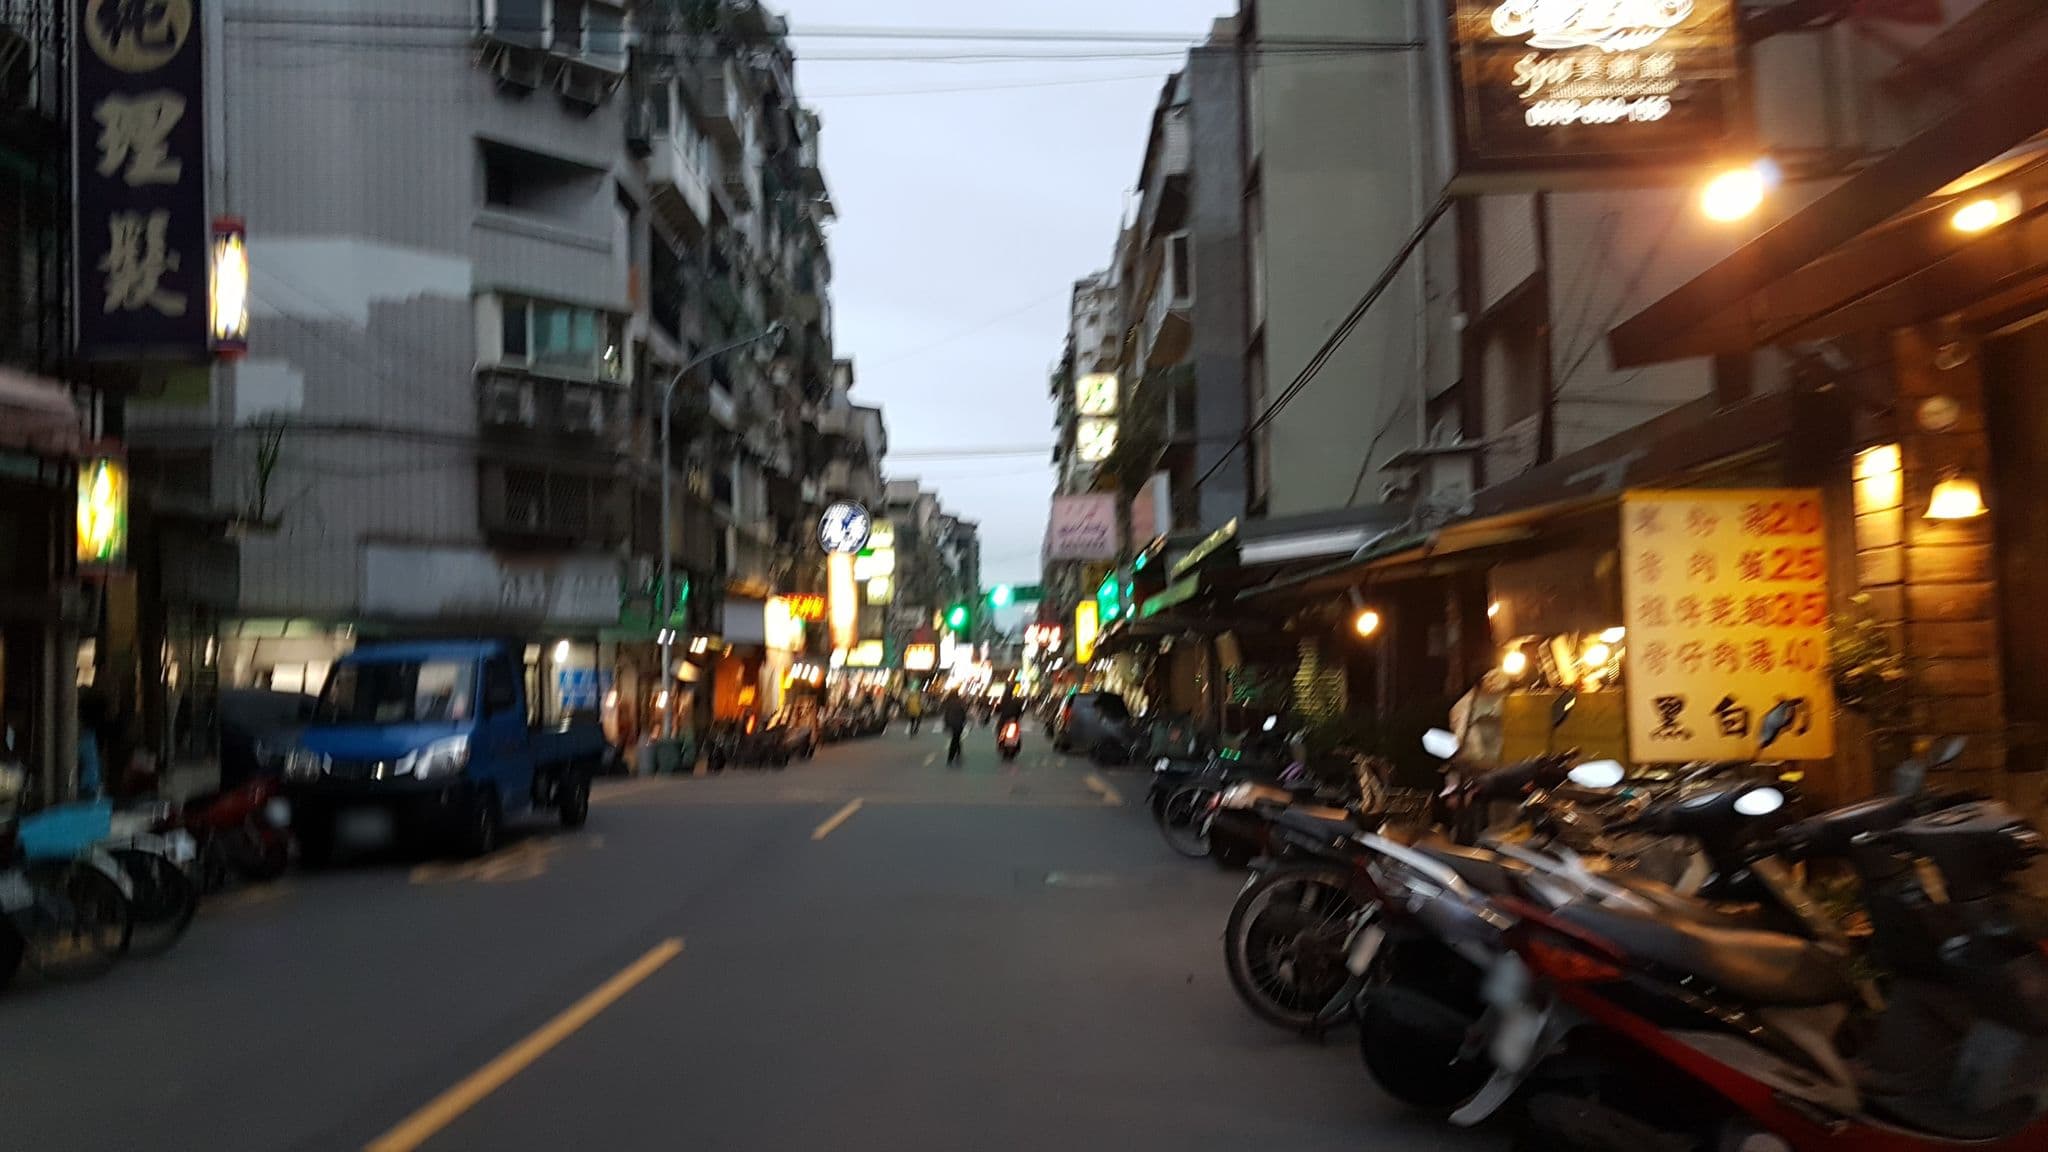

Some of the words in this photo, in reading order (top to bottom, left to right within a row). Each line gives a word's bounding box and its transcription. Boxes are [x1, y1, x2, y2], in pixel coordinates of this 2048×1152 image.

[1770, 501, 1819, 534] 20
[1768, 547, 1824, 580] 25
[1776, 592, 1825, 626] 35
[1781, 637, 1822, 673] 40
